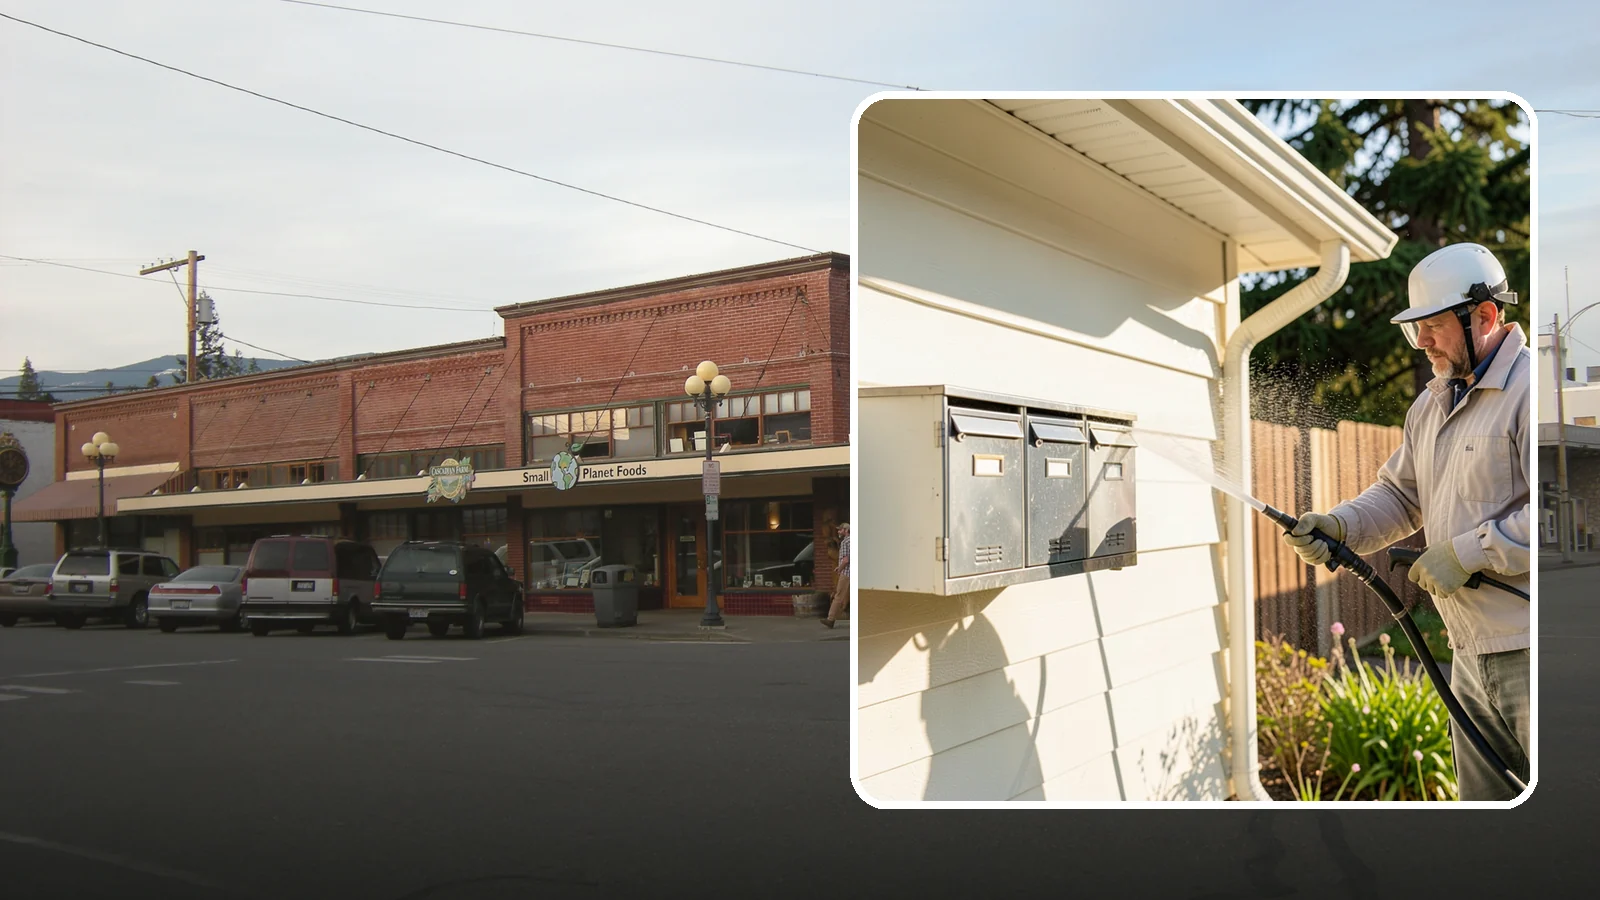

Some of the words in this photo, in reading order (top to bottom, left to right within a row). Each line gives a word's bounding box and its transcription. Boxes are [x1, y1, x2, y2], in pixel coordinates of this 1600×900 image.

[523, 470, 549, 483] Small
[582, 467, 614, 479] Planet
[616, 464, 647, 477] Foods
